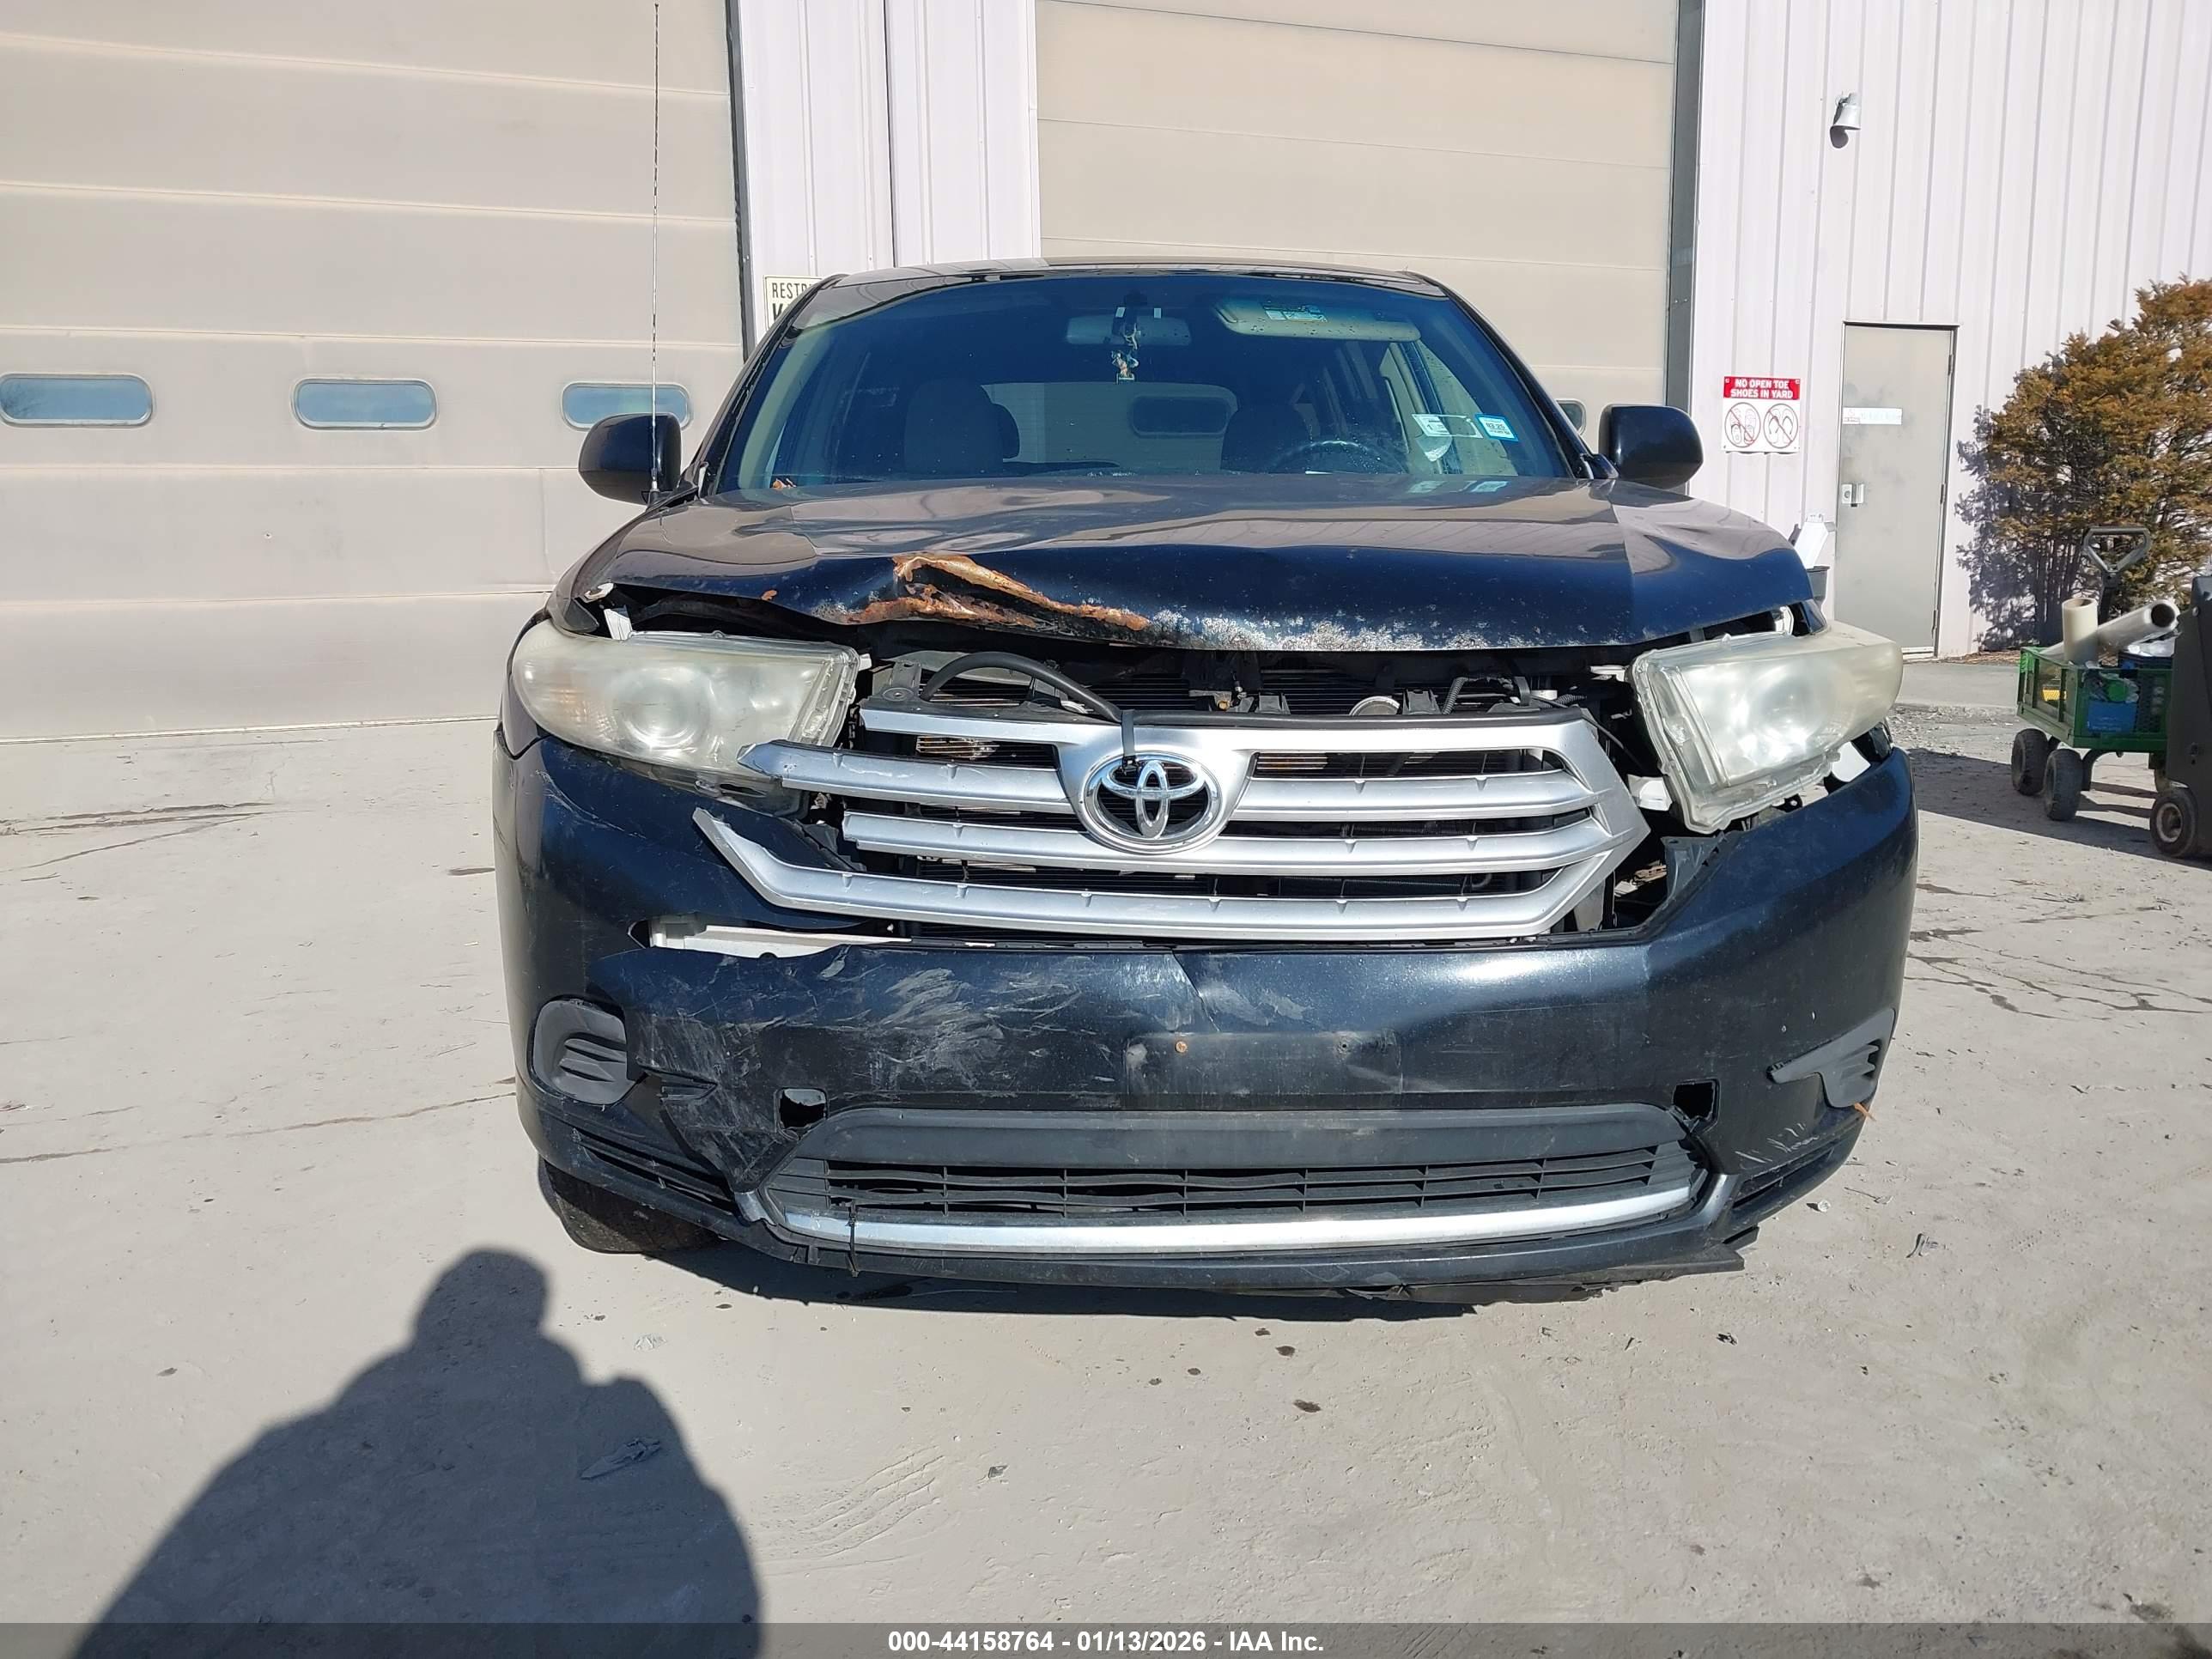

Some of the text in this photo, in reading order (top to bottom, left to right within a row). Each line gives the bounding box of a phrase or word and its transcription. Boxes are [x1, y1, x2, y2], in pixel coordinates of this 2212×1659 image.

[1735, 378, 1790, 389] NO OPEN TOE
[1730, 388, 1793, 398] SHOES IN YARD
